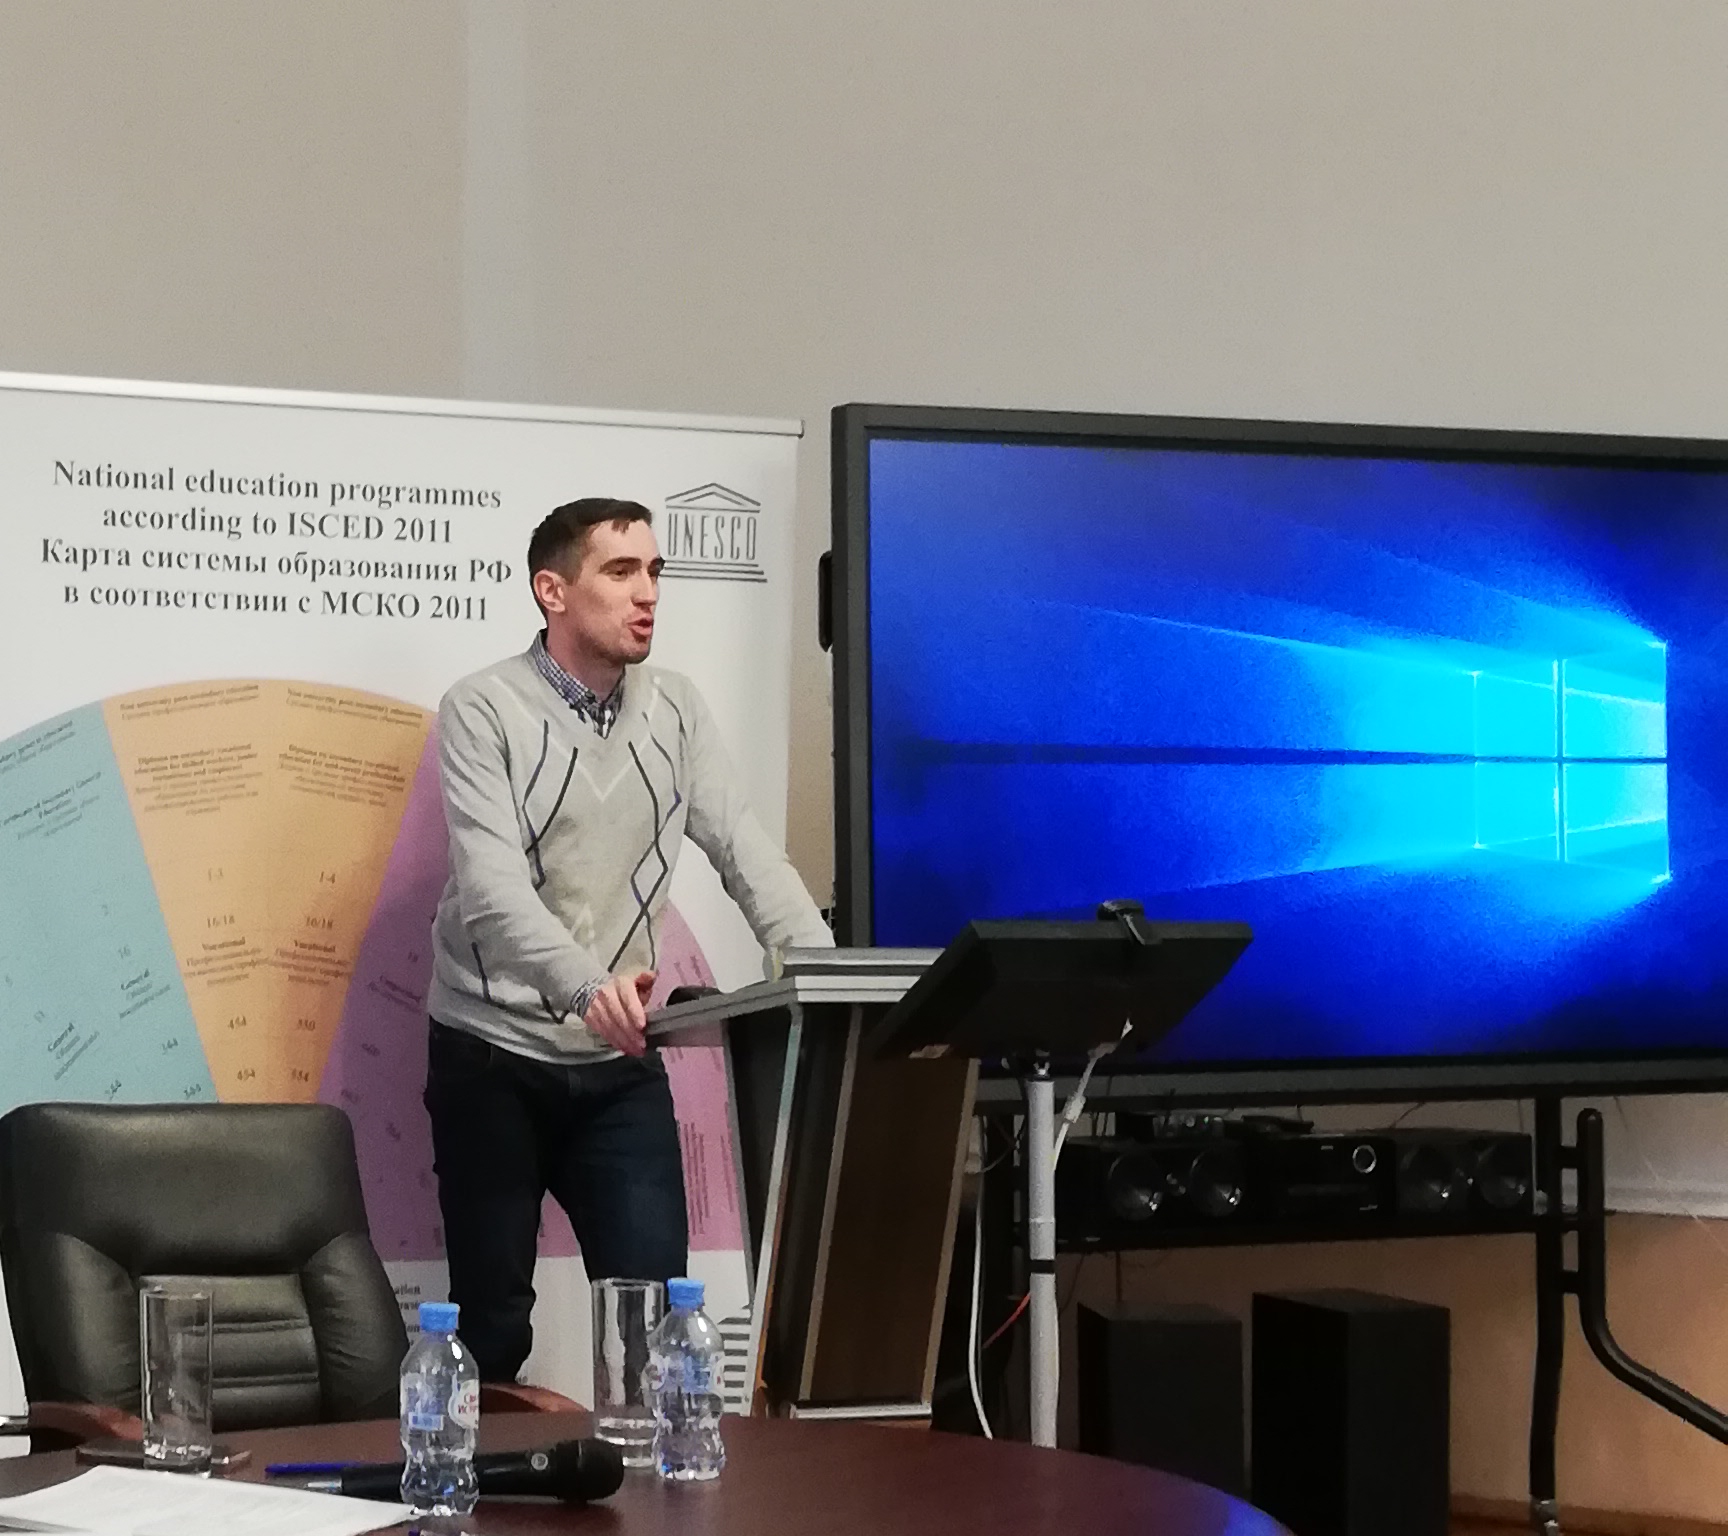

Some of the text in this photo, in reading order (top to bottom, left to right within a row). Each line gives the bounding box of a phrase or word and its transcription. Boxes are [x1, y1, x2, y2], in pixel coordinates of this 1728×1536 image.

[53, 460, 502, 510] National education programmes
[103, 507, 452, 543] according to ISCED 2011
[668, 513, 757, 561] UNESCO
[41, 538, 512, 583] Карта системы образования РФ
[64, 585, 486, 621] в соответствии с МСКО 2011
